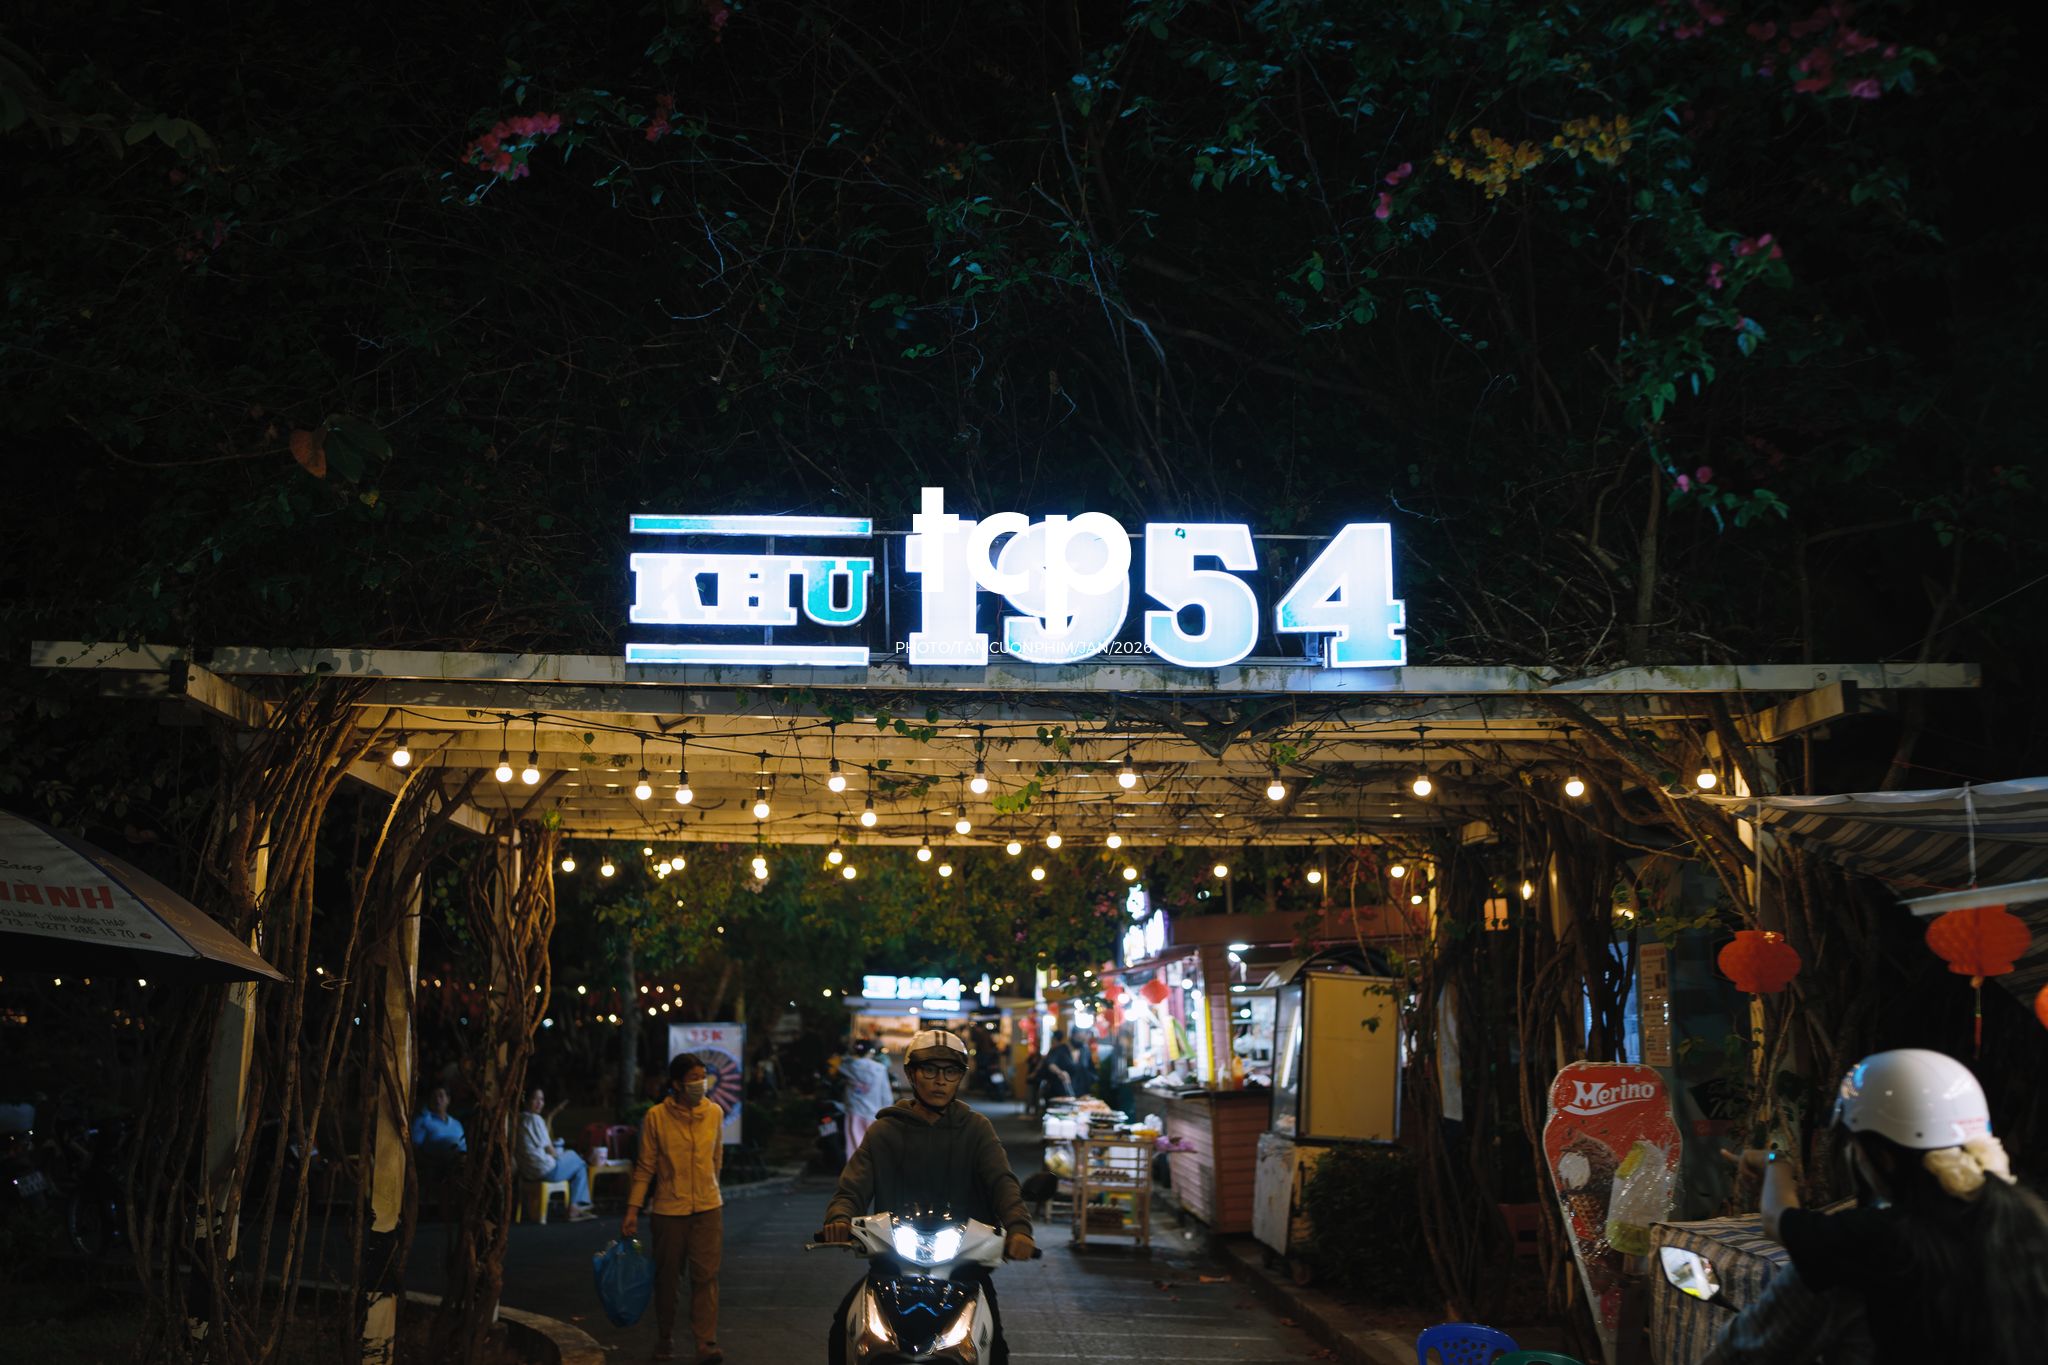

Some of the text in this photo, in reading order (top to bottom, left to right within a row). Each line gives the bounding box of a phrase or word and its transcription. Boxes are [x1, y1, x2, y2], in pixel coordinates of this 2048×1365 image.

[630, 520, 1407, 669] KHU 1954
[1571, 1077, 1655, 1107] Merino
